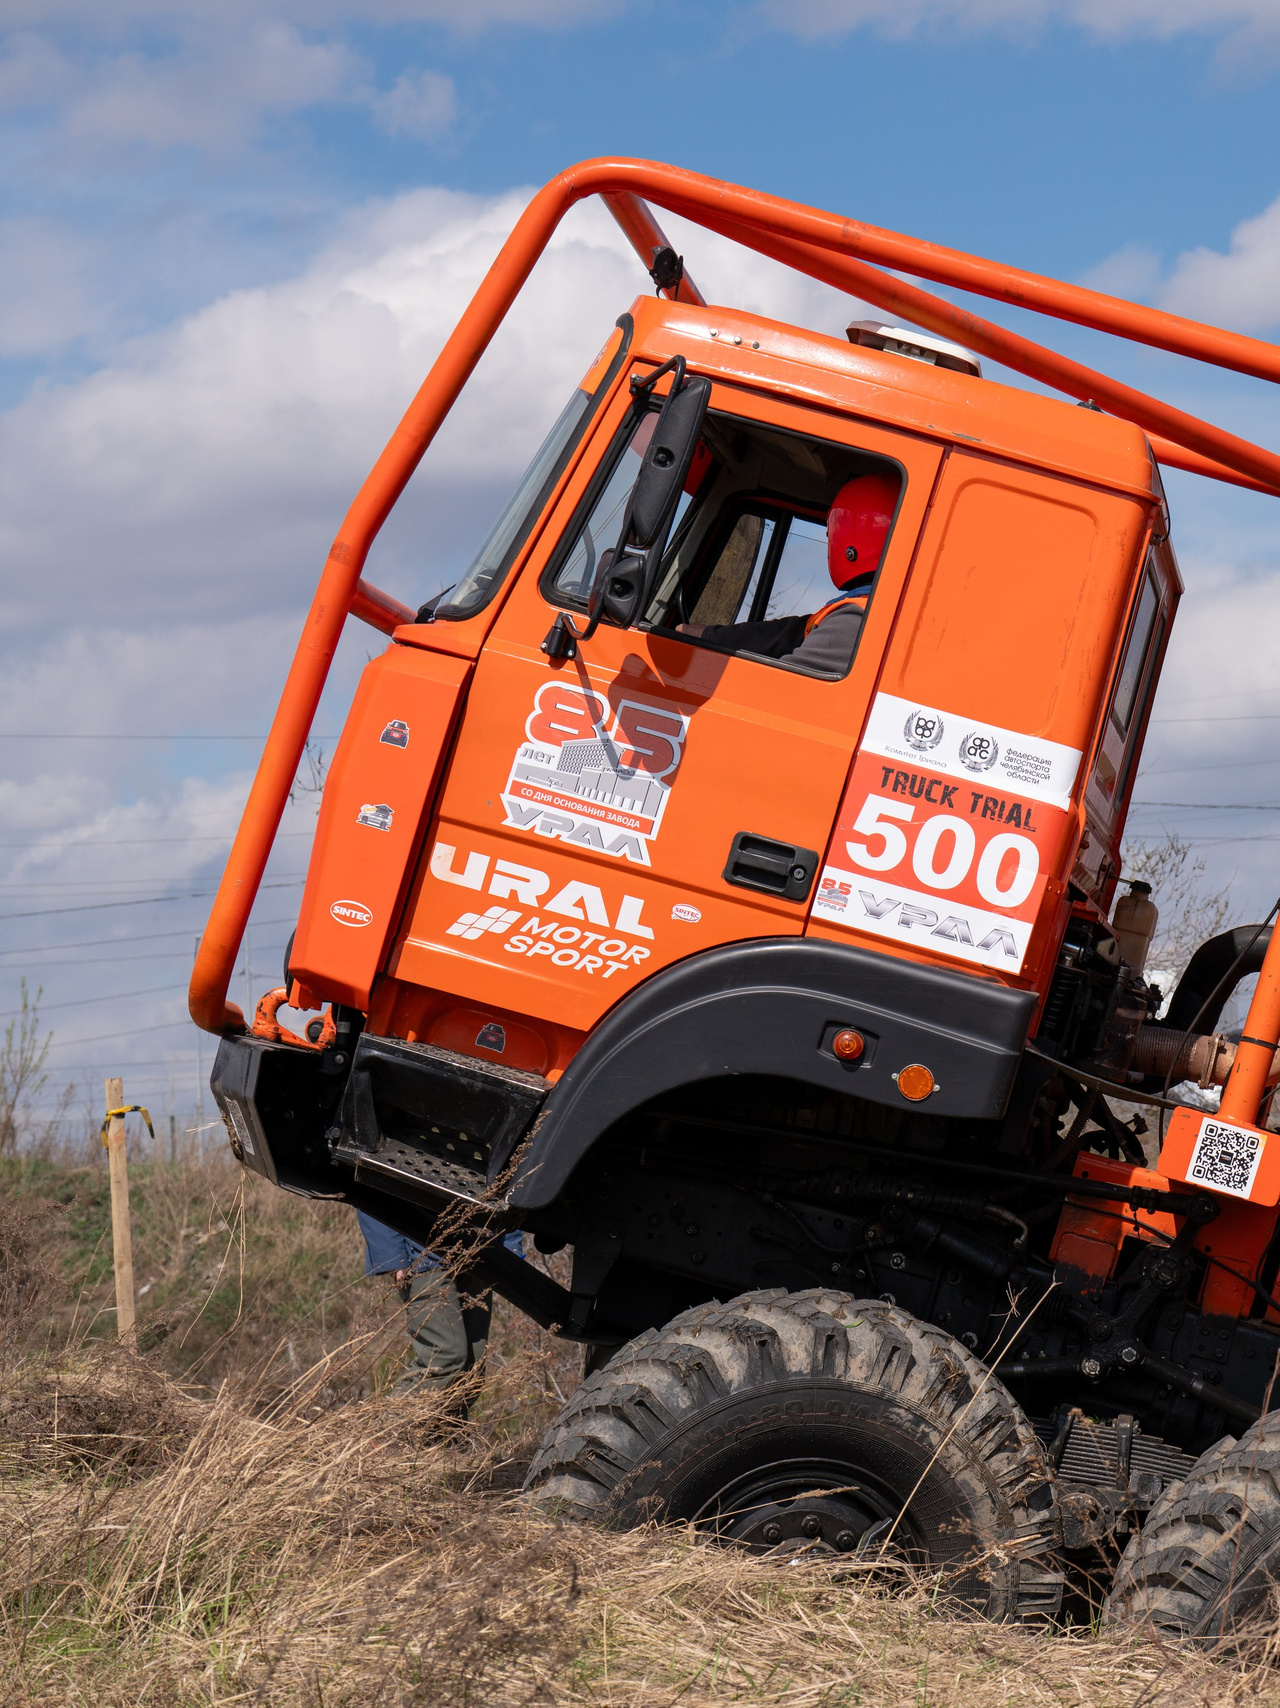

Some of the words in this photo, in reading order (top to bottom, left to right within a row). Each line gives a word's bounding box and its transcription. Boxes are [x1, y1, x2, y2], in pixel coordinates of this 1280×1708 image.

[527, 683, 687, 775] 85
[521, 747, 555, 765] лет
[885, 745, 917, 759] Комитет
[919, 755, 947, 768] Триала
[1000, 761, 1051, 780] челябинской
[1004, 756, 1050, 773] автоспорта
[1006, 770, 1040, 785] области
[521, 787, 533, 797] СО
[533, 790, 552, 803] ДНЯ
[553, 797, 605, 818] ОСНОВАНИЯ
[606, 812, 640, 828] ЗАВОДА
[881, 765, 959, 809] TRUCK
[969, 791, 1036, 832] TRIAL
[506, 800, 644, 861] УРАЛ
[846, 794, 1039, 907] 500
[430, 842, 655, 940] URAL
[821, 878, 852, 895] 85
[333, 905, 370, 922] SINTEC
[675, 907, 700, 919] SINTEC
[859, 890, 1018, 959] УРАЛ
[503, 935, 629, 978] SPORT
[519, 917, 650, 965] MOTOR
